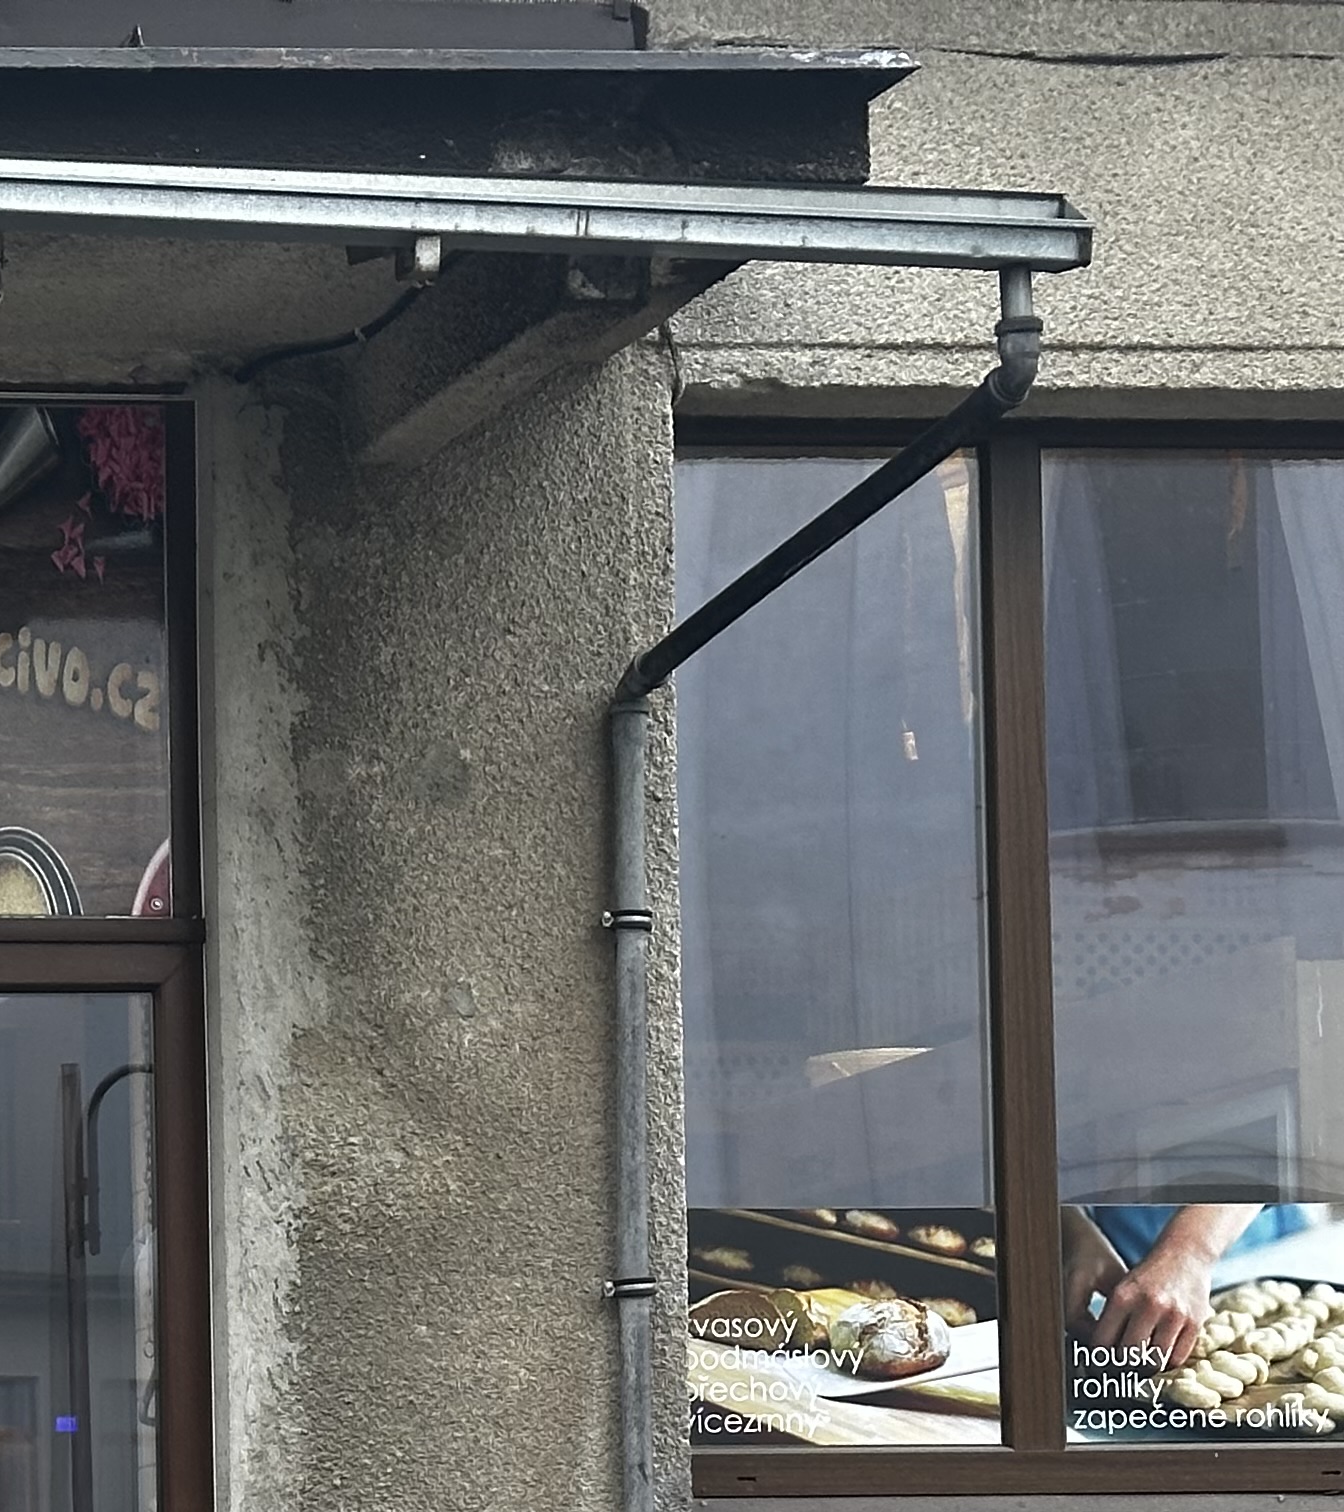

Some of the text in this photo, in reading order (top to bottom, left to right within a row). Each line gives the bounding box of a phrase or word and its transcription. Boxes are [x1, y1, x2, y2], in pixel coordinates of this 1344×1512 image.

[688, 1311, 798, 1343] vasový
[1073, 1338, 1172, 1372] housky
[1073, 1371, 1163, 1406] rohlíky
[1073, 1400, 1330, 1434] zapečené rohlíky
